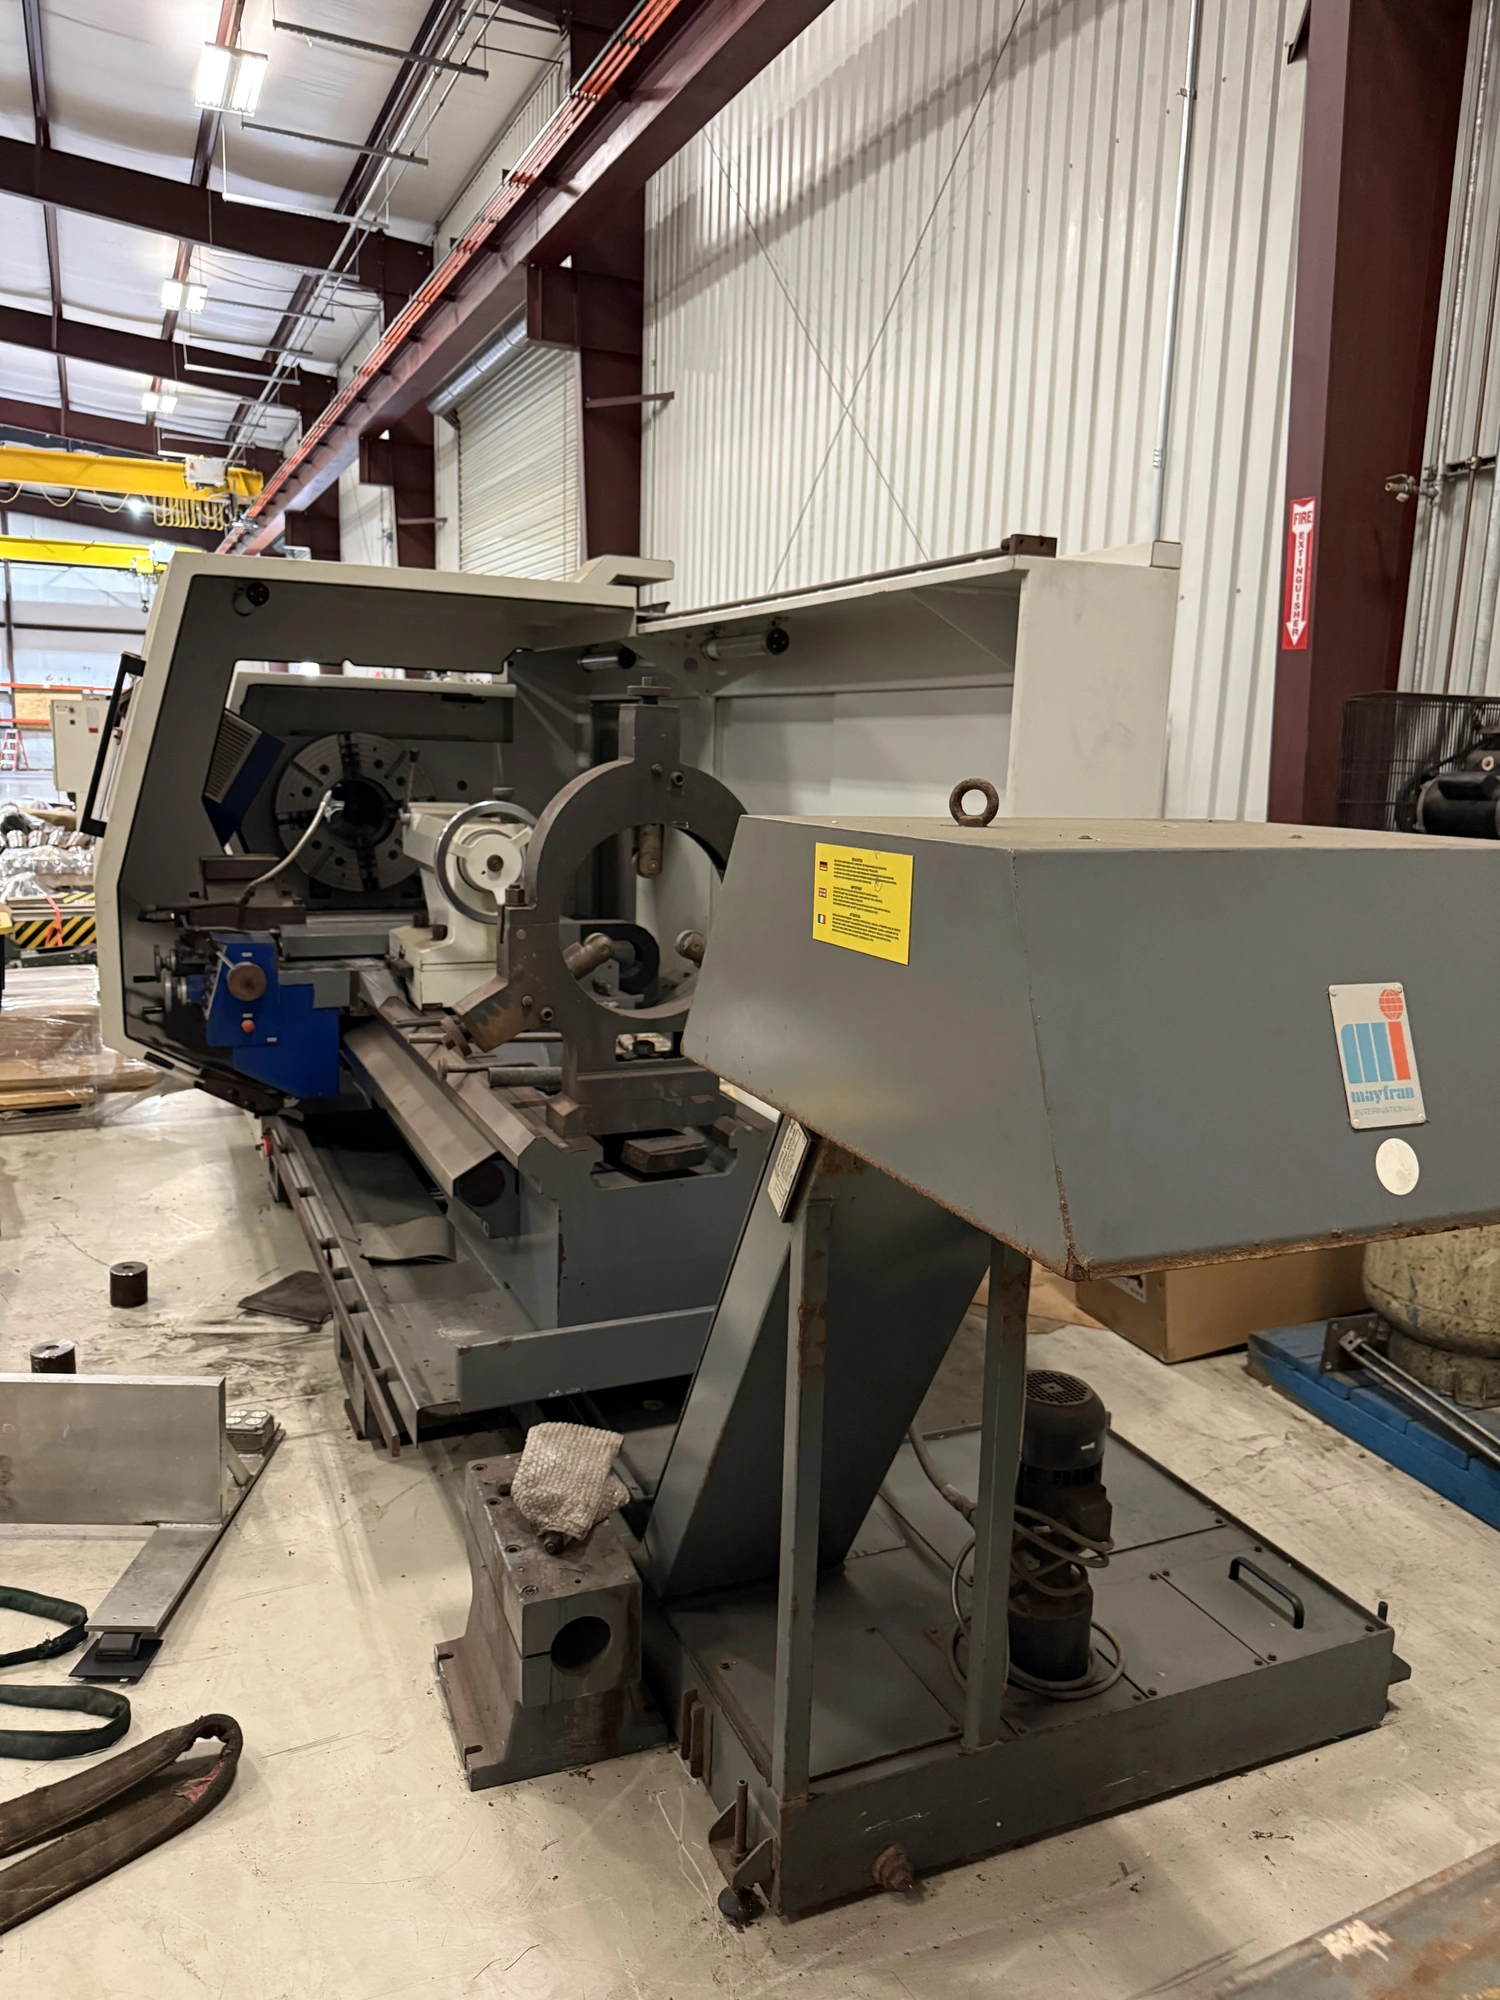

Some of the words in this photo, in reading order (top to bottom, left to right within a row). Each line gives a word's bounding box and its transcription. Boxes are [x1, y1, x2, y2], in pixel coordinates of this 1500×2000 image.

[1293, 511, 1312, 525] FIRE
[1292, 532, 1305, 635] EXTINGUISHER
[1351, 1086, 1414, 1103] mayfran
